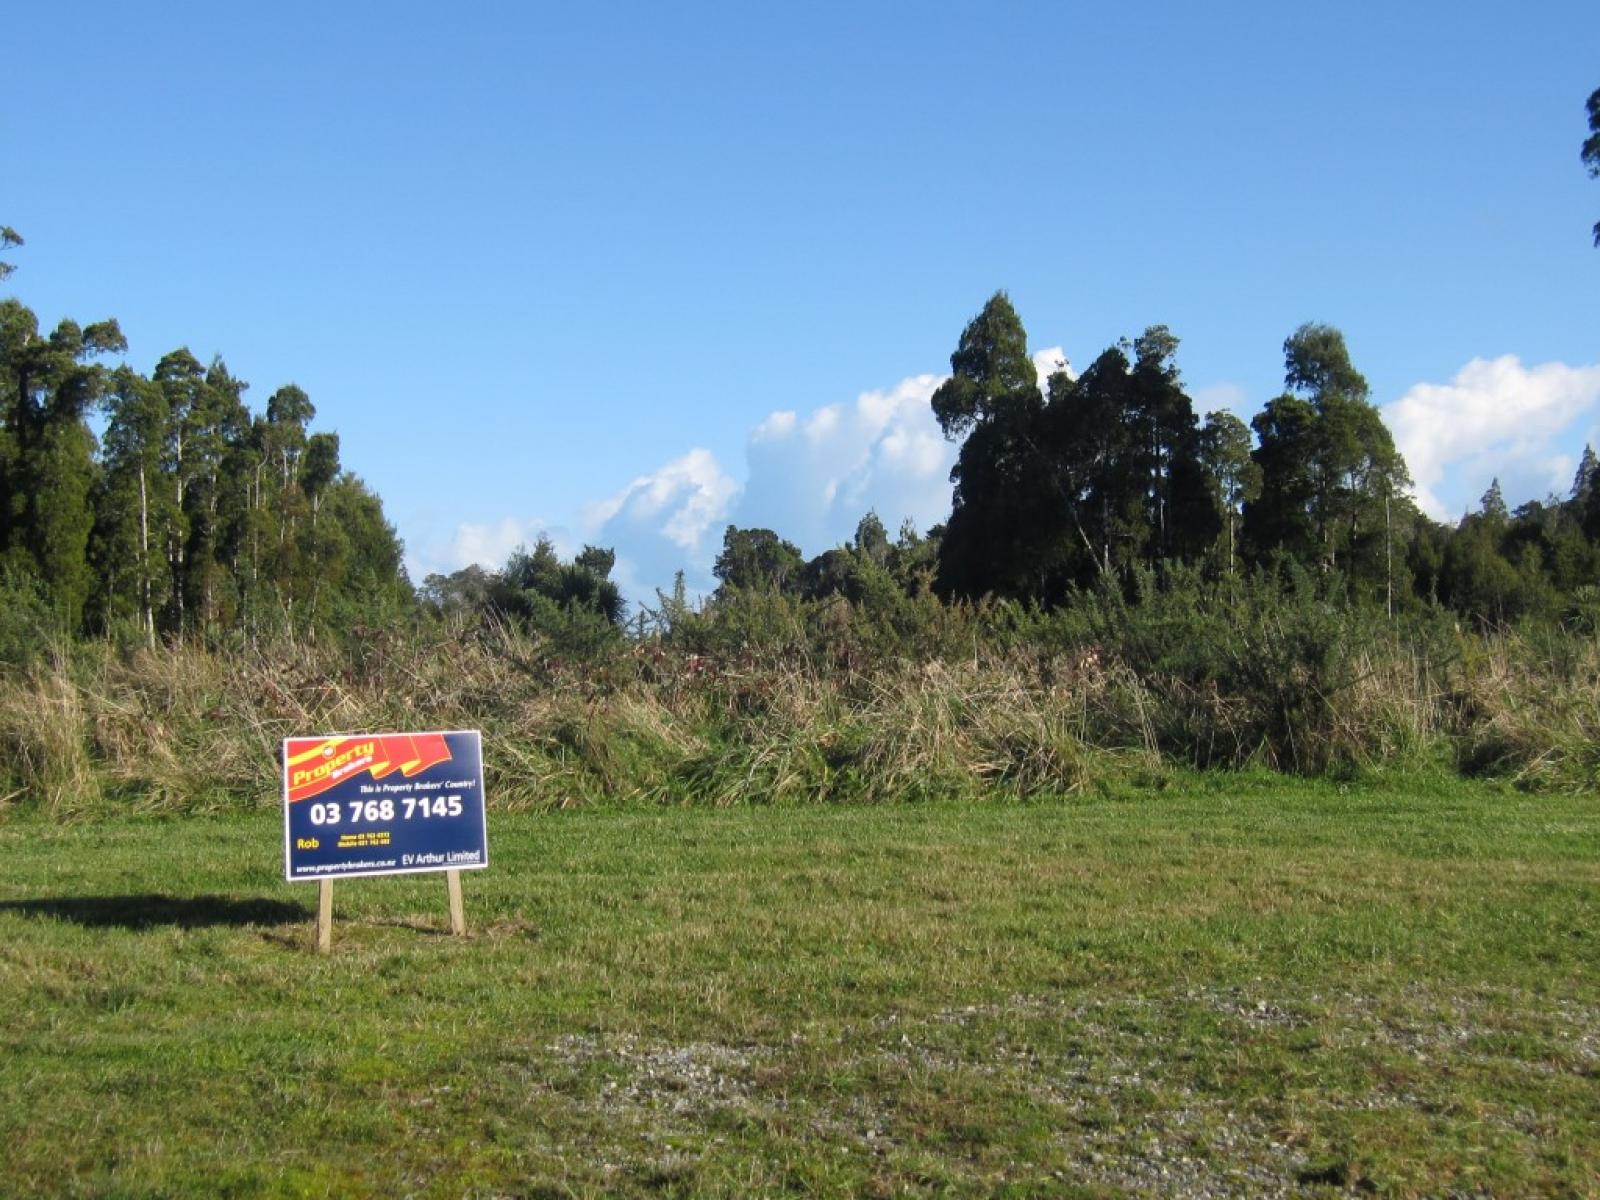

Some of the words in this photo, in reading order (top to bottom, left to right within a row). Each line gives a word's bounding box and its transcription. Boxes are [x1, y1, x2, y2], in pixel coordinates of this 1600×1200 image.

[293, 741, 374, 785] Property
[360, 785, 374, 793] This
[375, 785, 382, 793] is
[383, 783, 413, 795] Property
[445, 779, 476, 791] Country!
[310, 802, 341, 825] 03
[349, 799, 395, 823] 768
[402, 795, 463, 820] 7145
[297, 838, 320, 849] Rob
[402, 854, 414, 866] EV
[415, 852, 445, 865] Arthur
[447, 850, 481, 862] Limited
